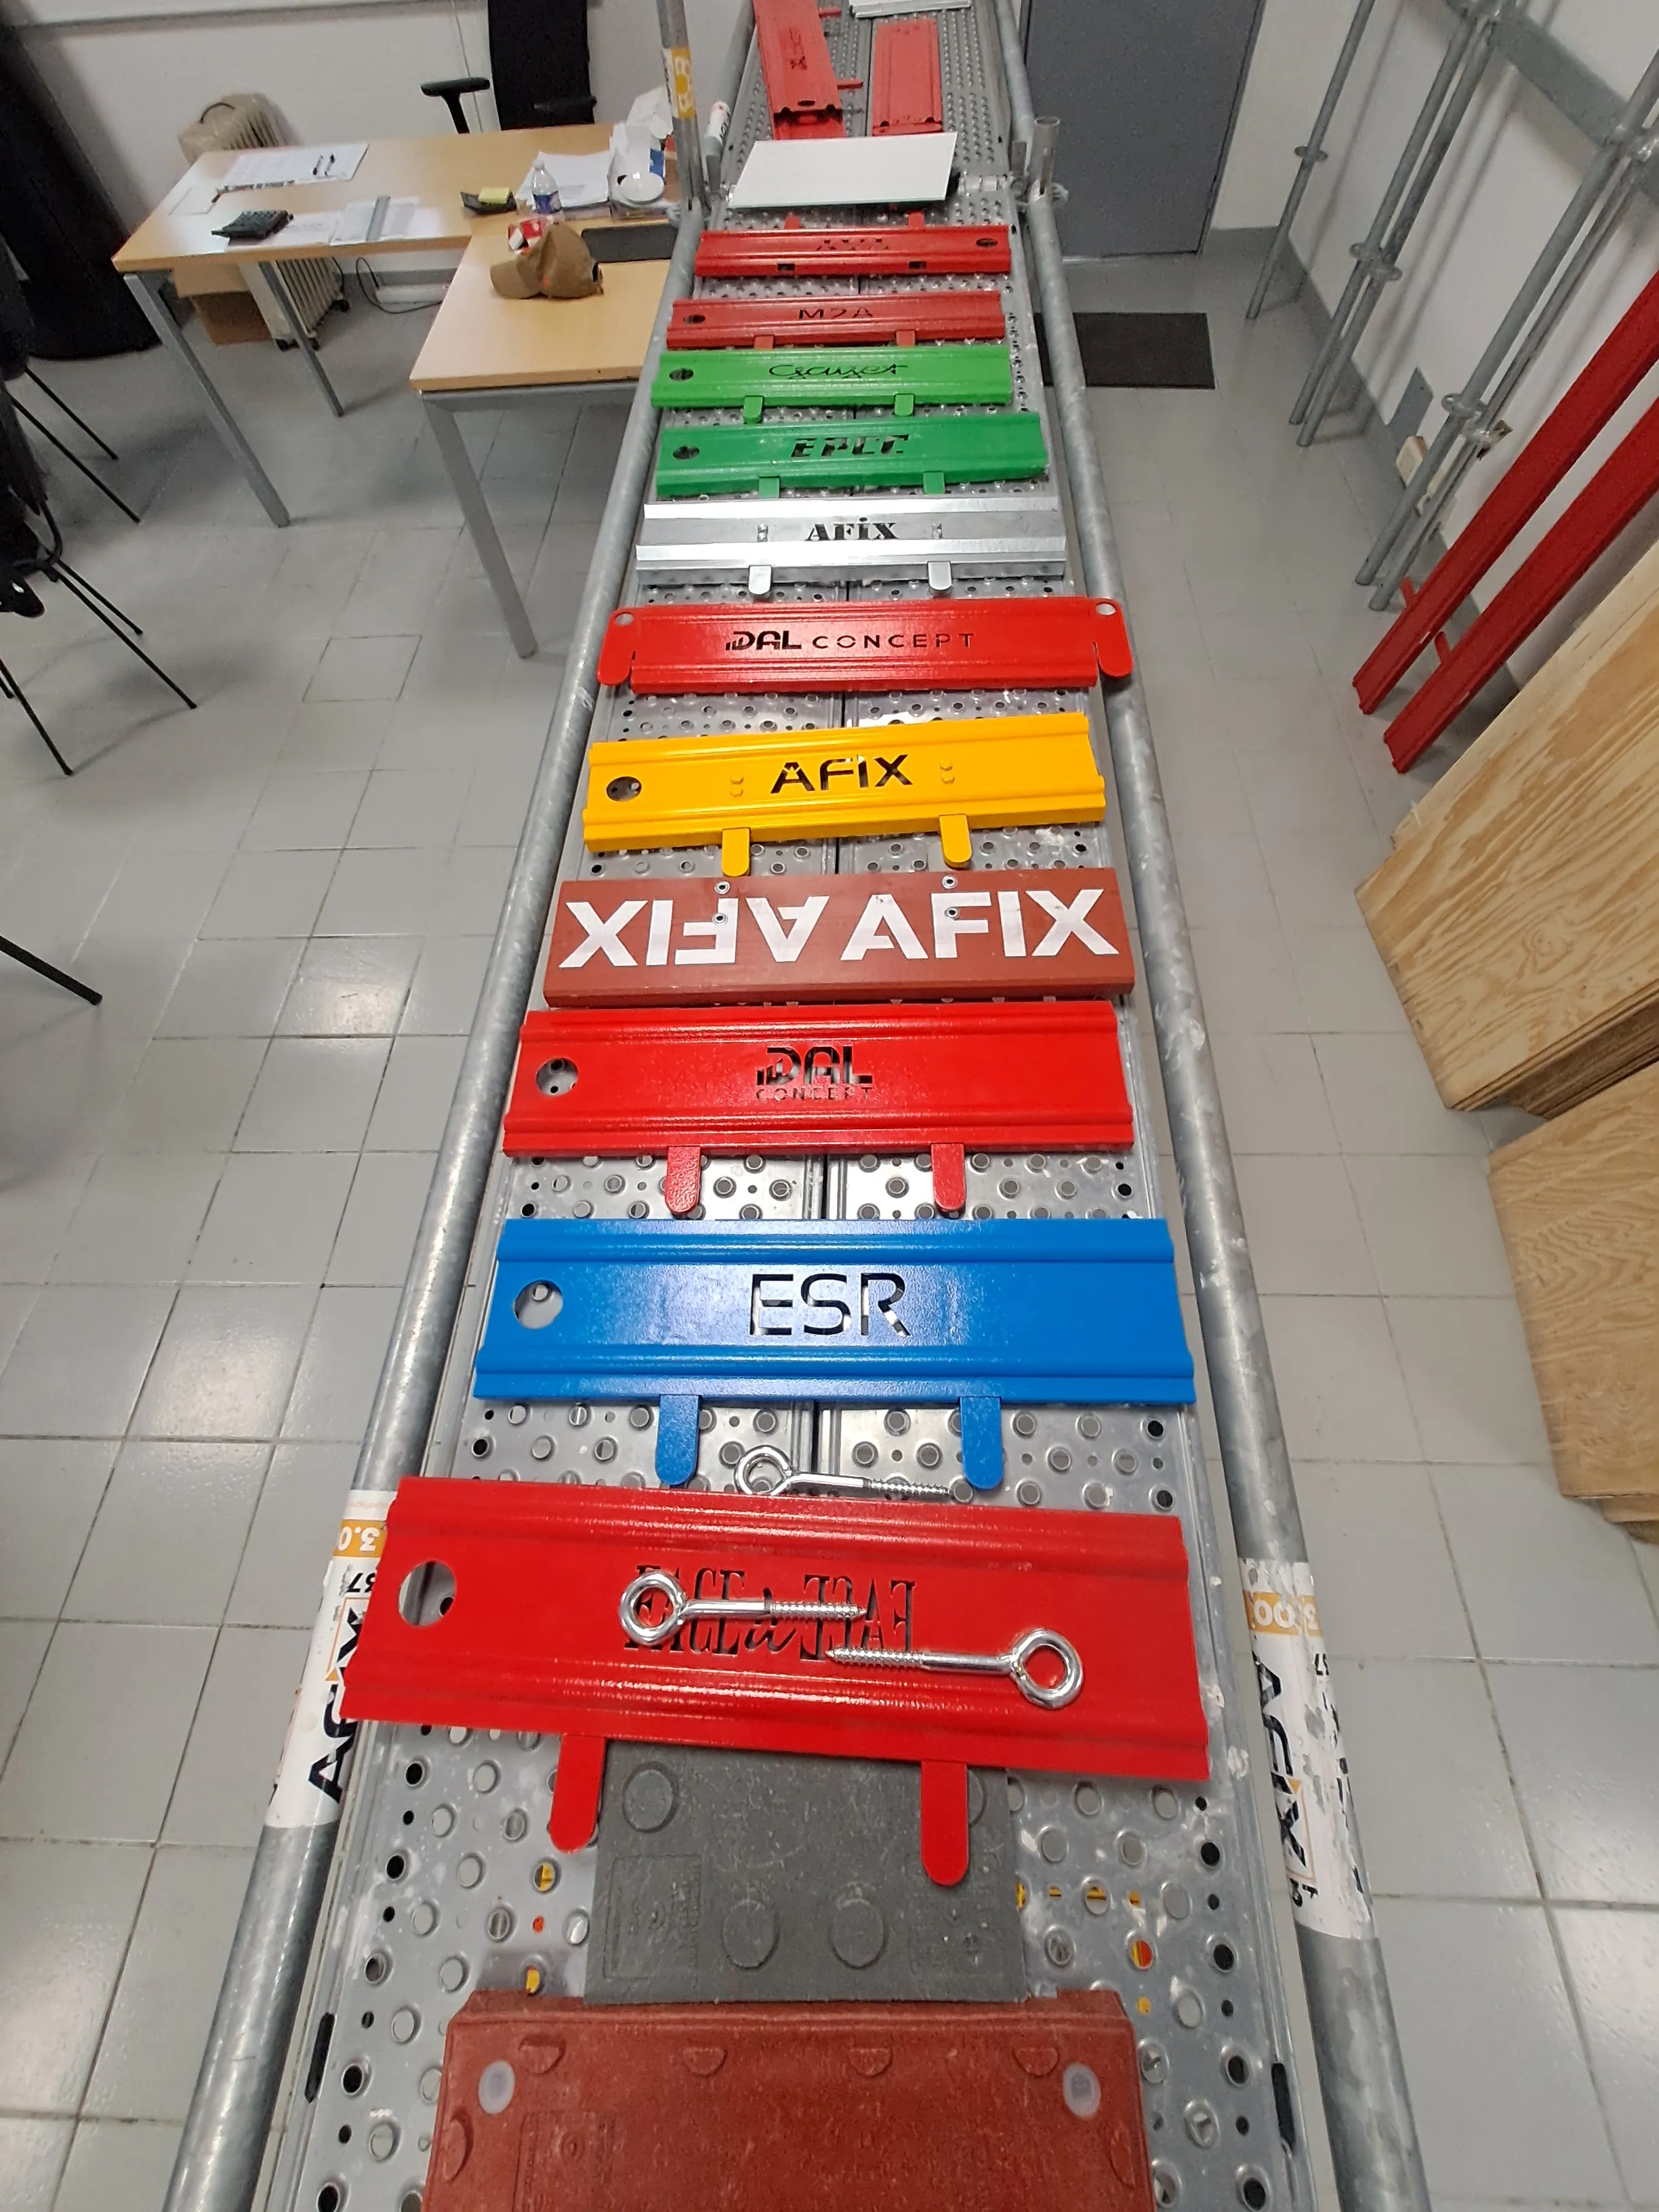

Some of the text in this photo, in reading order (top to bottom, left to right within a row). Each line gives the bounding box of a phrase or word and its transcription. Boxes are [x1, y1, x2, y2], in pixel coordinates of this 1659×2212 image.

[812, 633, 975, 649] CONCEPT
[840, 888, 1120, 962] AFIX
[756, 1086, 873, 1103] CONCEPT
[750, 1272, 911, 1337] ESR
